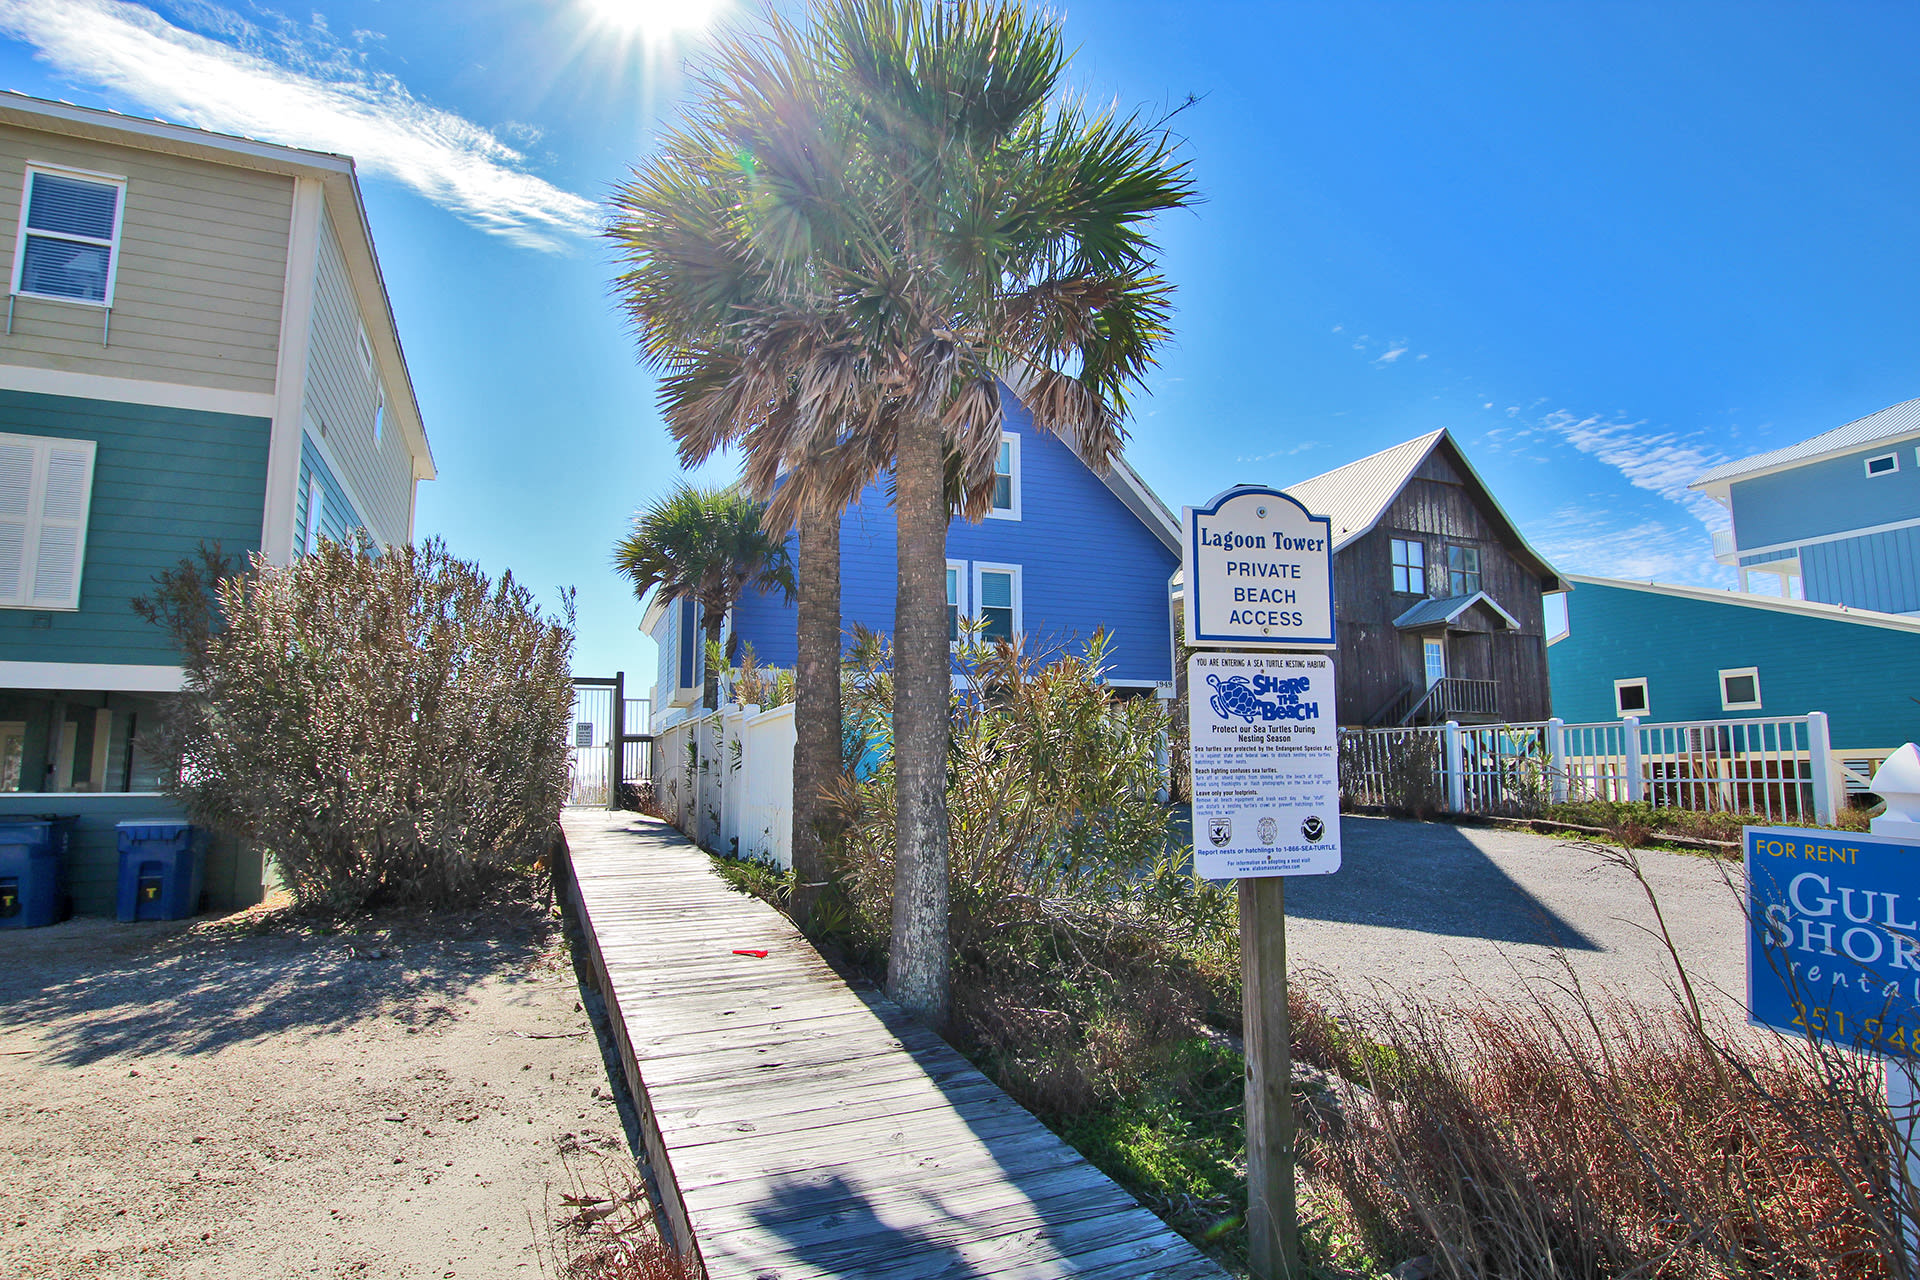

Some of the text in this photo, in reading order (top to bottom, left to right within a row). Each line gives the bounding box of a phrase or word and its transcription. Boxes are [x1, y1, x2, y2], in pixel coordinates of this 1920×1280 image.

[1202, 528, 1324, 551] Lagoon Tower
[1227, 562, 1301, 578] PRIVATE
[1234, 588, 1296, 603] BEACH
[1230, 610, 1303, 626] ACCESS
[1196, 658, 1207, 666] YOU
[1294, 726, 1315, 734] During
[1239, 734, 1264, 743] Nesting
[1756, 840, 1859, 864] FOR RENT
[1789, 872, 1920, 931] GUL
[1792, 1002, 1844, 1036] 251
